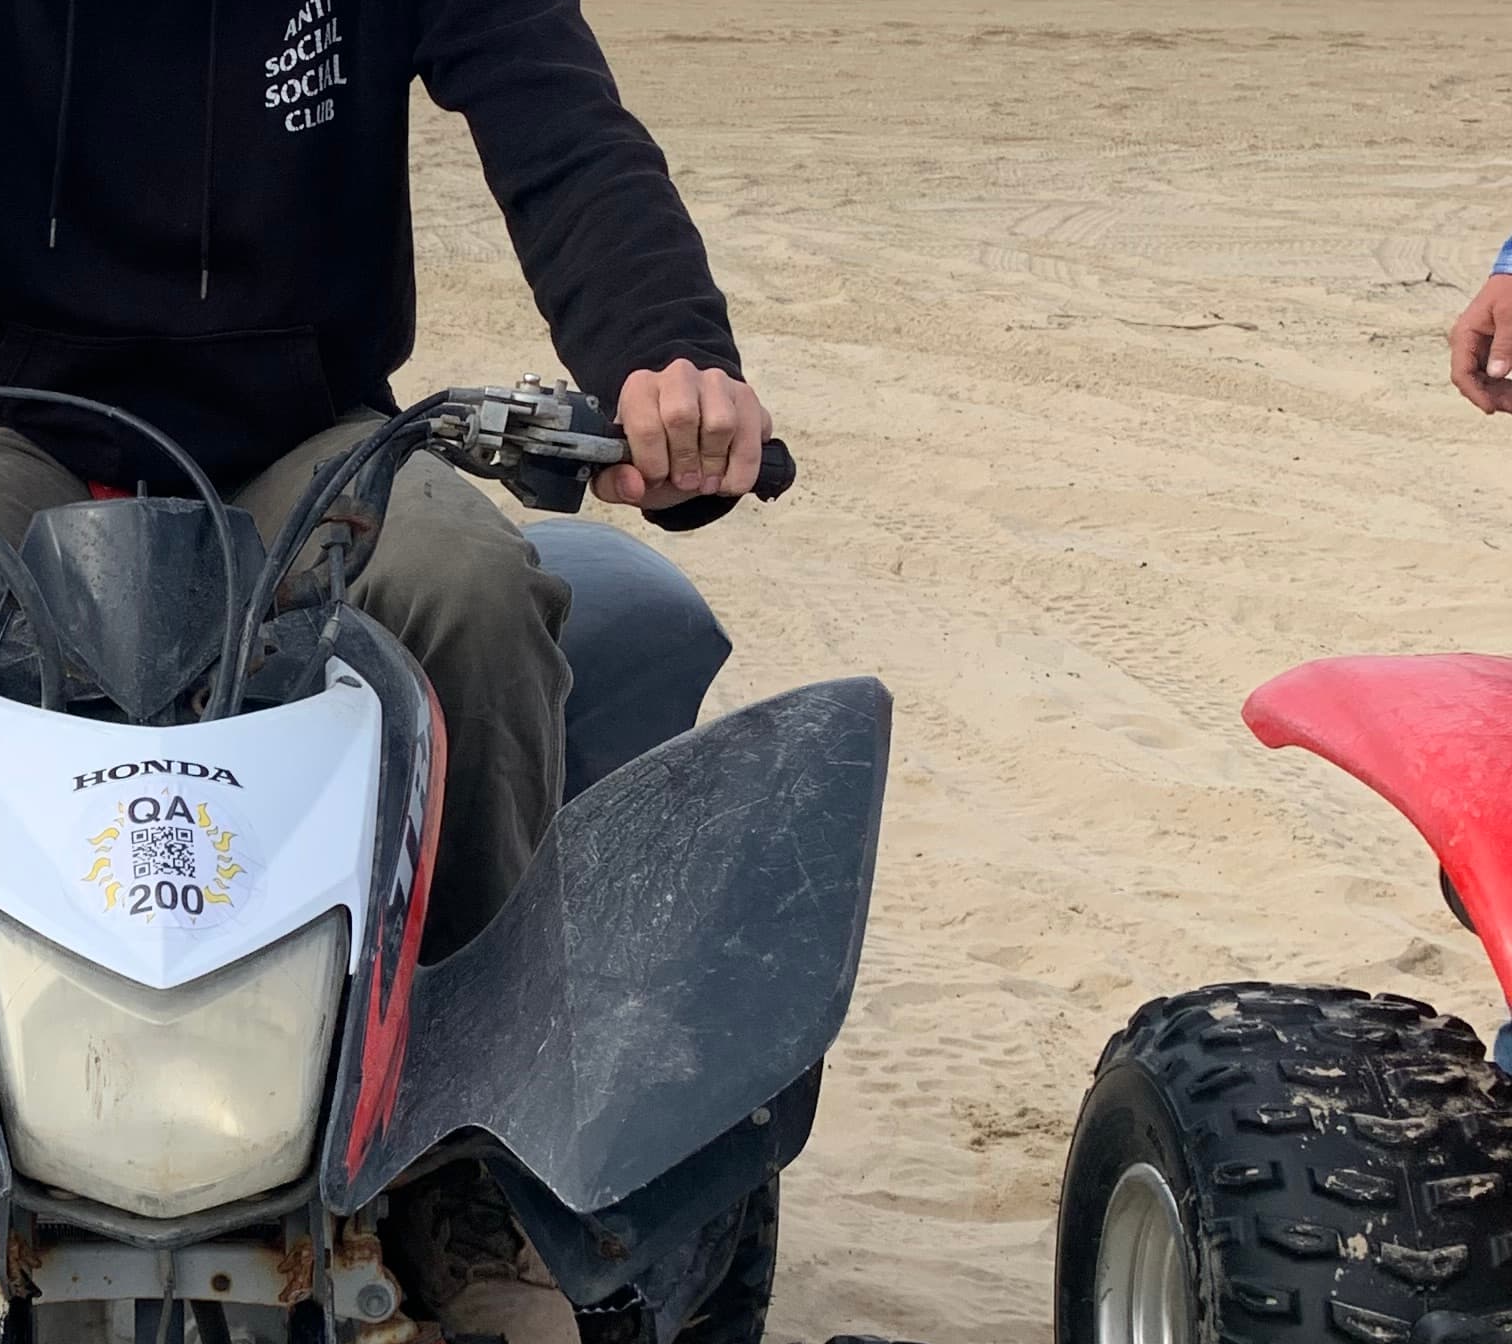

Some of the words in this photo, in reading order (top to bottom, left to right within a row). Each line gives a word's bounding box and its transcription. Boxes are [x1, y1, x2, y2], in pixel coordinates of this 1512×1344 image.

[265, 17, 342, 77] SOCIAL
[265, 54, 347, 108] SOCIAL
[285, 98, 334, 132] CLUB
[73, 759, 244, 792] HONDA
[128, 796, 195, 824] QA
[129, 881, 205, 915] 200
